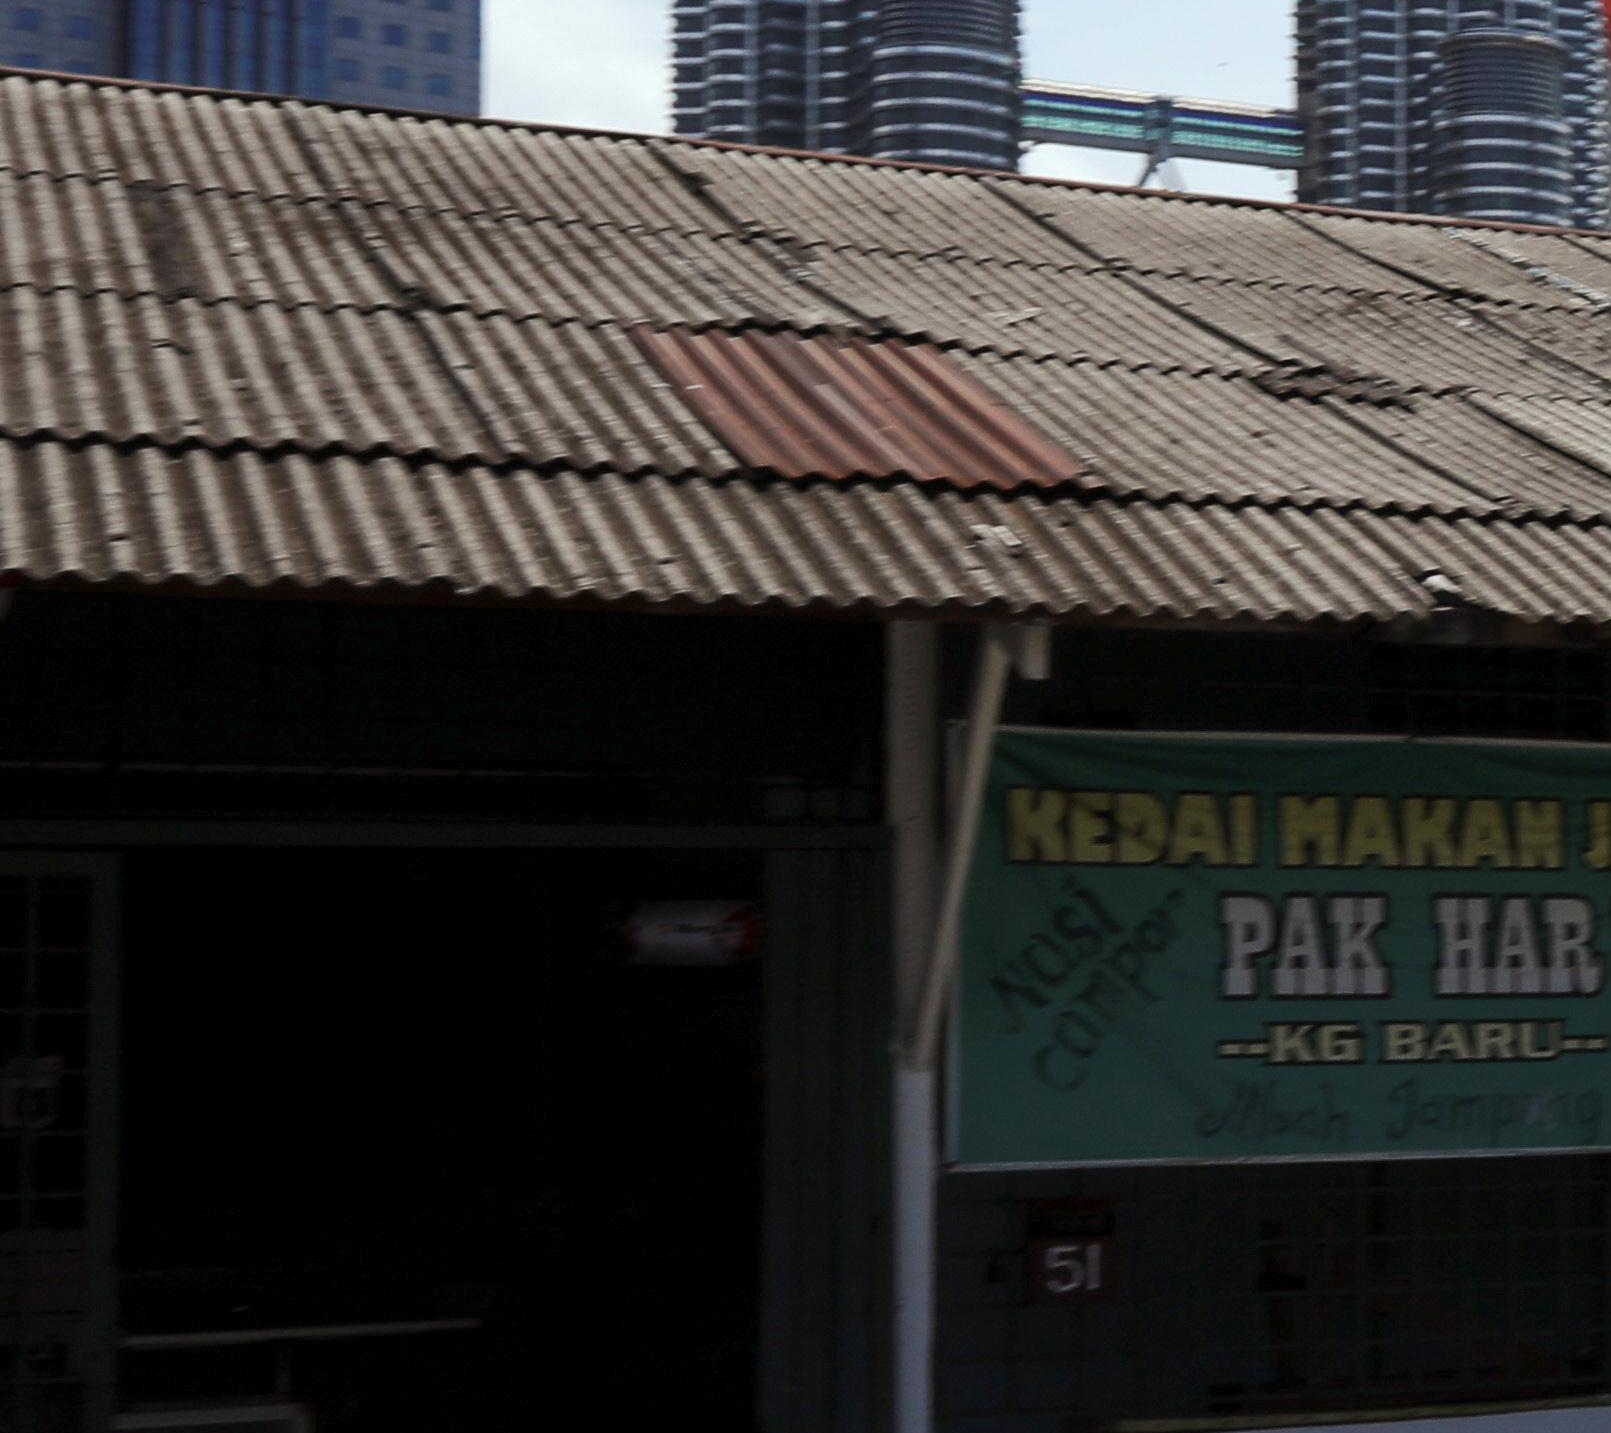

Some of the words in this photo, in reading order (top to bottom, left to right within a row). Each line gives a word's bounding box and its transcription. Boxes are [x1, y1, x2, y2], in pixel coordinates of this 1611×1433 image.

[1004, 785, 1257, 867] KEDAI
[1275, 791, 1567, 870] MAKAN
[1219, 892, 1390, 999] PAK
[1044, 1242, 1103, 1293] 51
